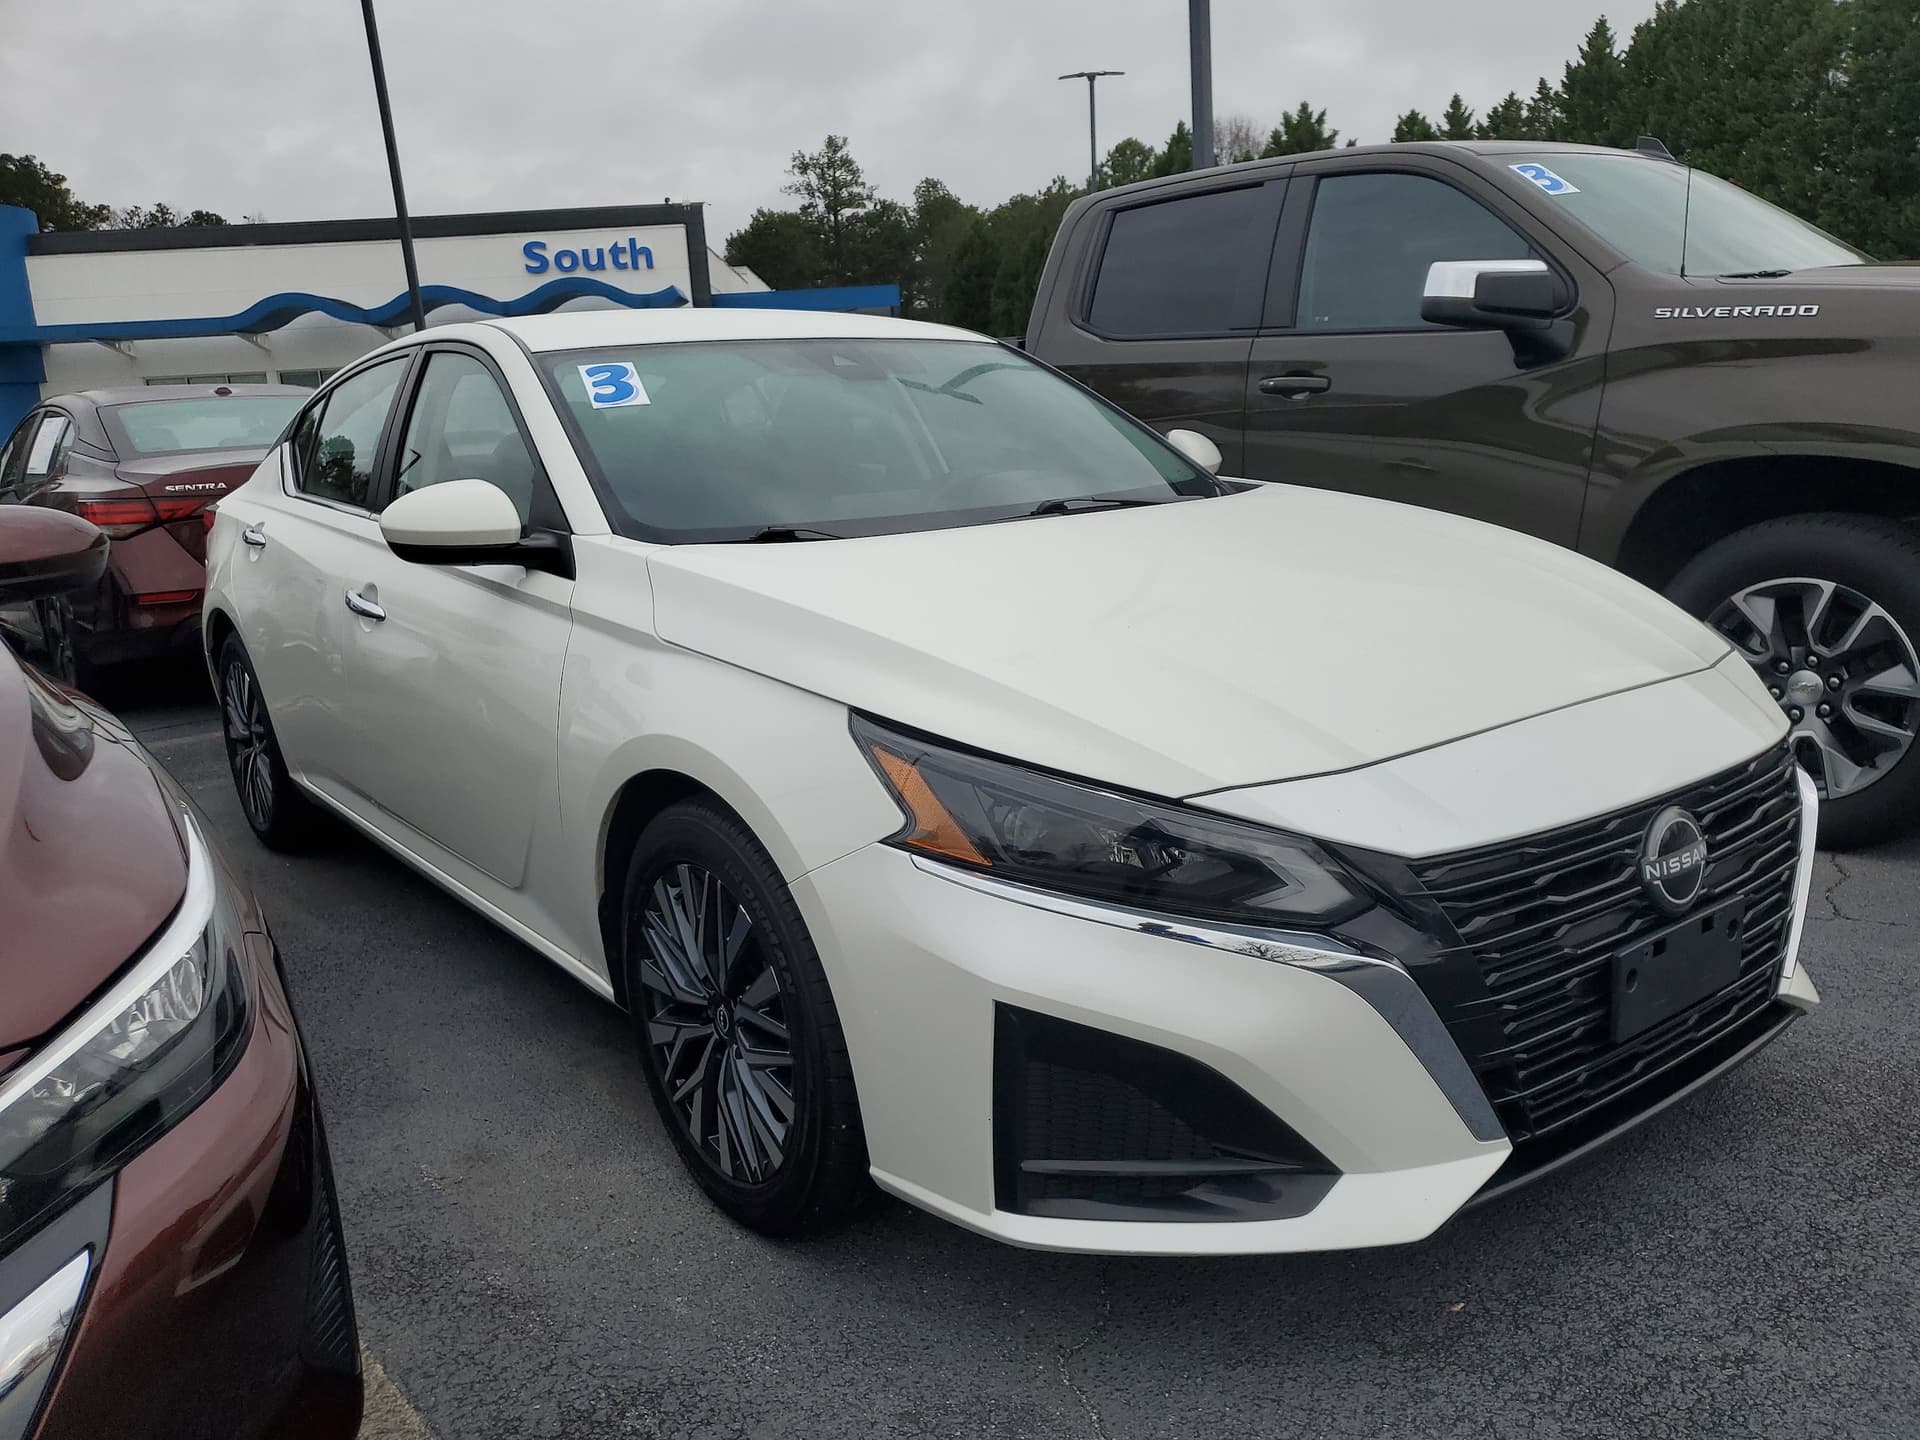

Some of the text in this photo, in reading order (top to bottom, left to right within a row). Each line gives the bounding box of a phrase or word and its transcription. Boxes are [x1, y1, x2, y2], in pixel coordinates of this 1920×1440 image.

[1516, 165, 1564, 191] 3
[523, 238, 654, 274] South
[1654, 304, 1820, 318] SILVERADO
[585, 364, 635, 403] 3
[165, 482, 228, 492] SENTRA
[1645, 843, 1708, 880] NISSAN
